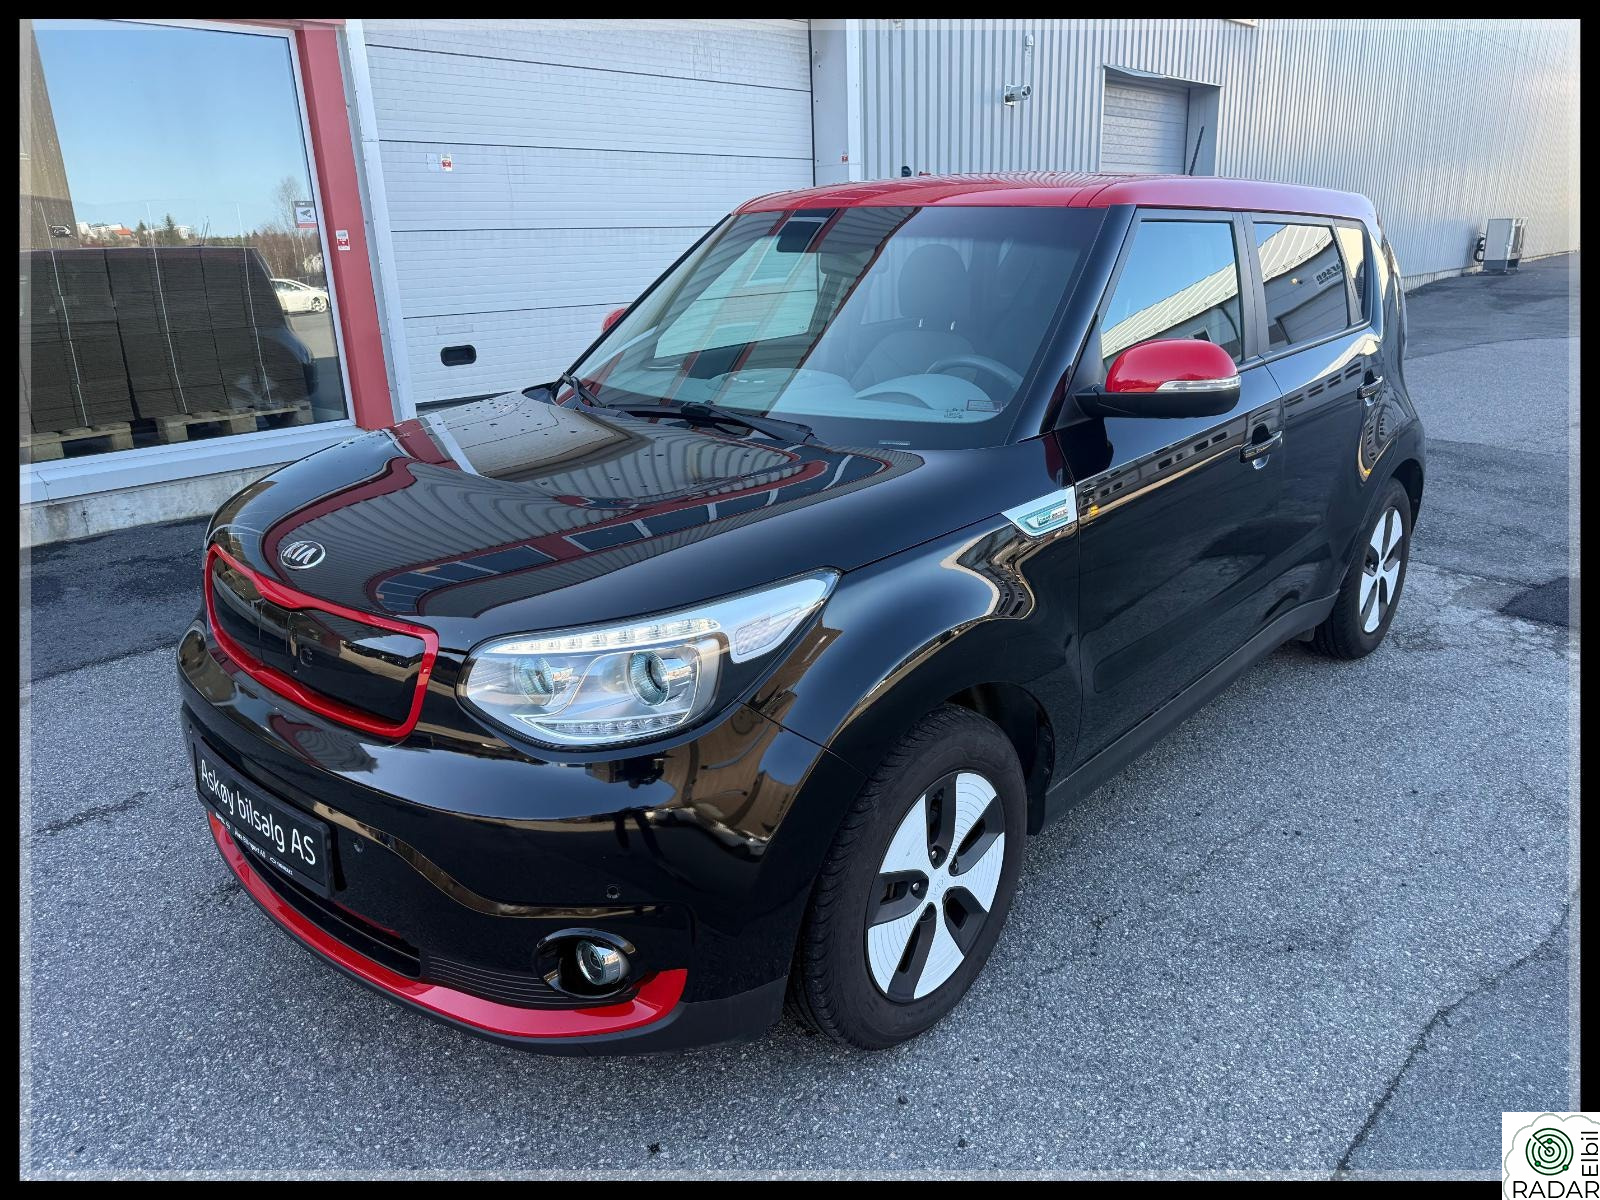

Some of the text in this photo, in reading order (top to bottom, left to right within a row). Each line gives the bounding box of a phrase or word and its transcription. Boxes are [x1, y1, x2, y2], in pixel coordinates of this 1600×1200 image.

[283, 541, 317, 565] KIA
[201, 759, 234, 816] Askøy
[236, 790, 285, 853] bilsalg
[291, 828, 316, 865] AS
